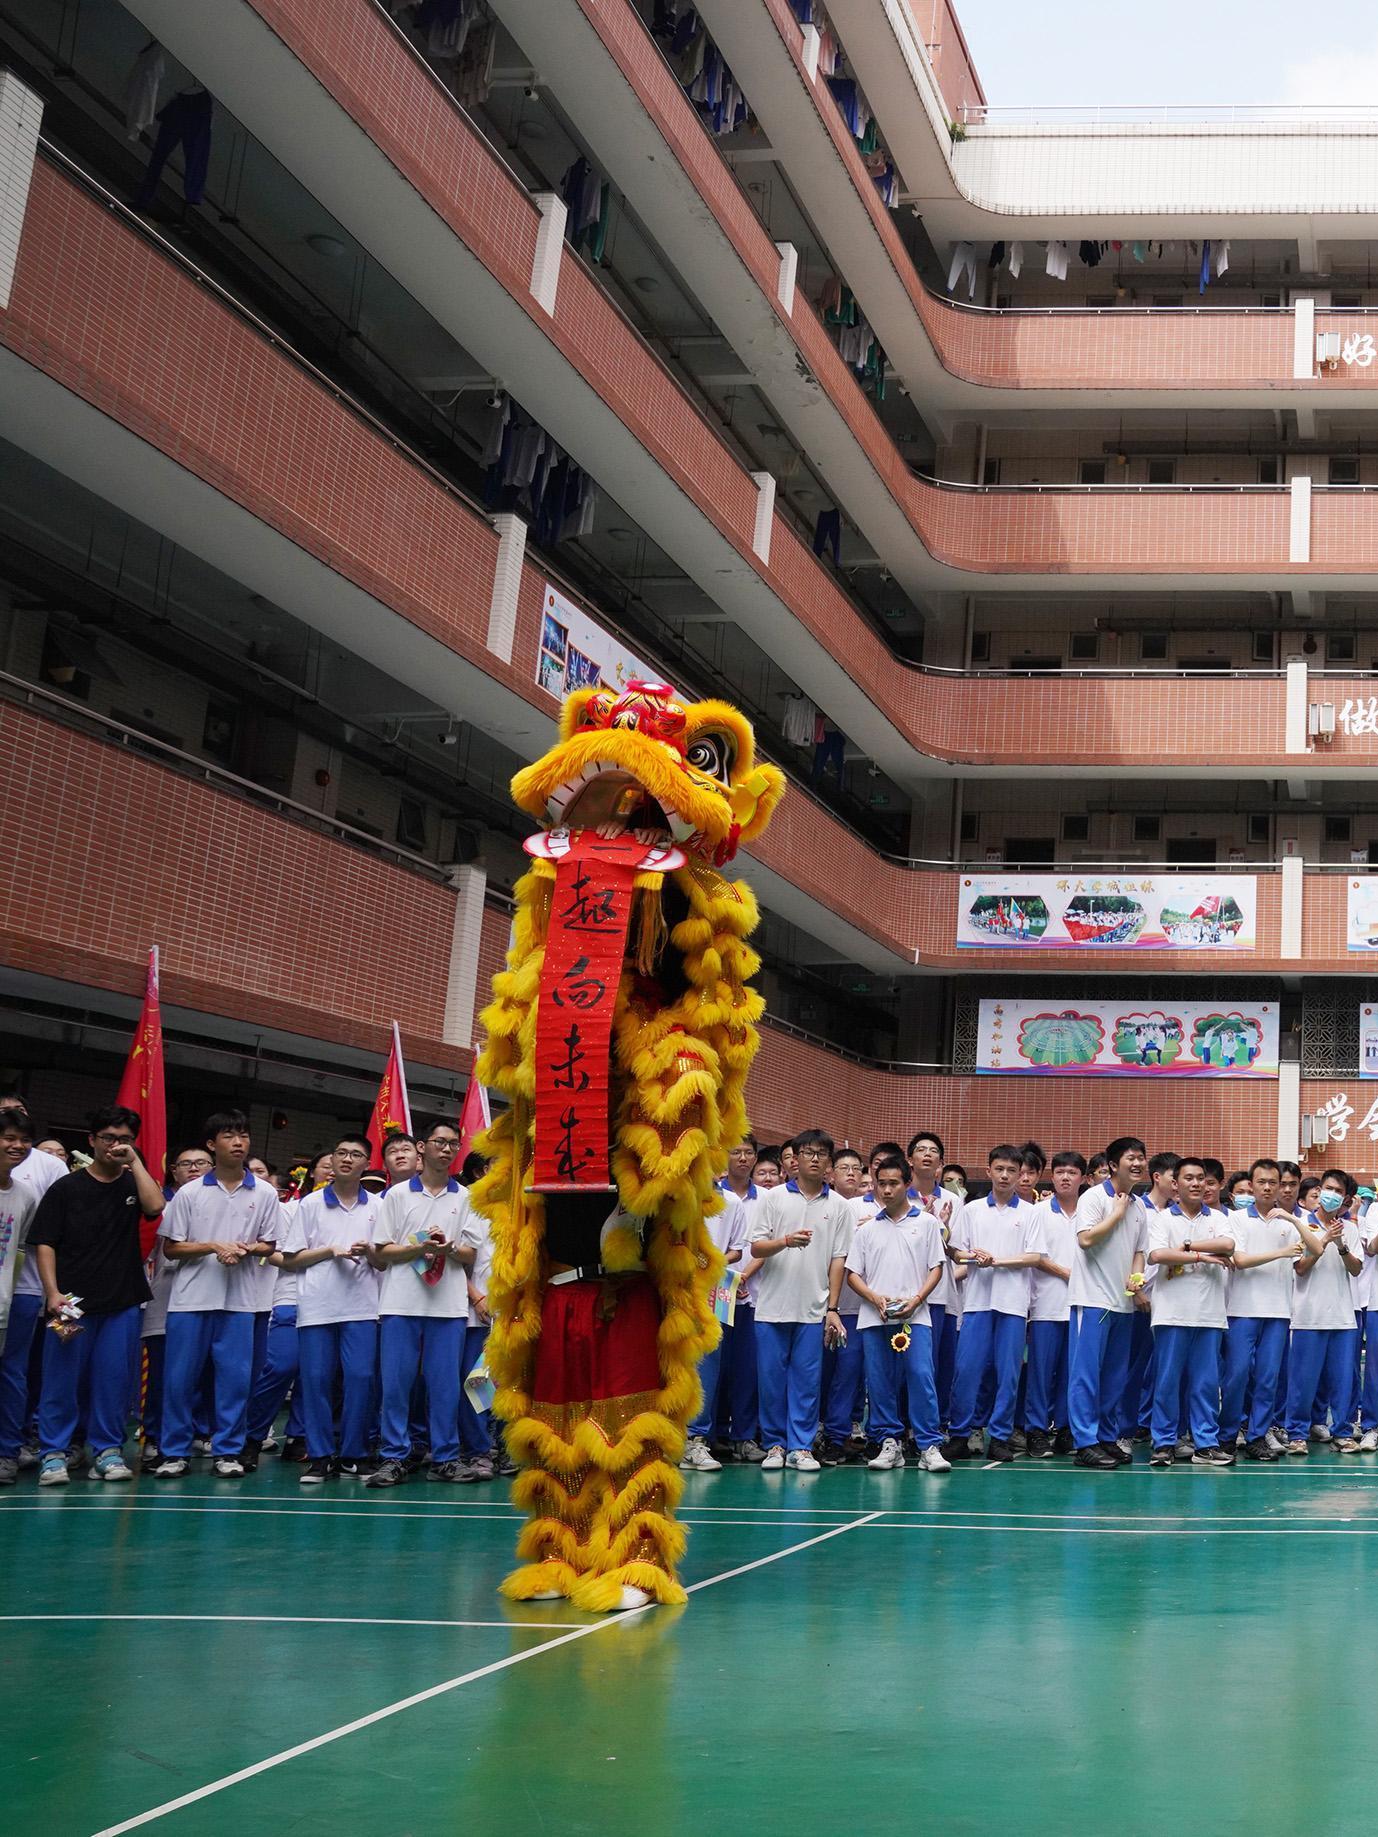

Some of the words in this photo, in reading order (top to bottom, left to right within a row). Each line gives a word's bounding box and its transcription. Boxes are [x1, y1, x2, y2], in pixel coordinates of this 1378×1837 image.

[550, 845, 632, 1182] 一起向未来
